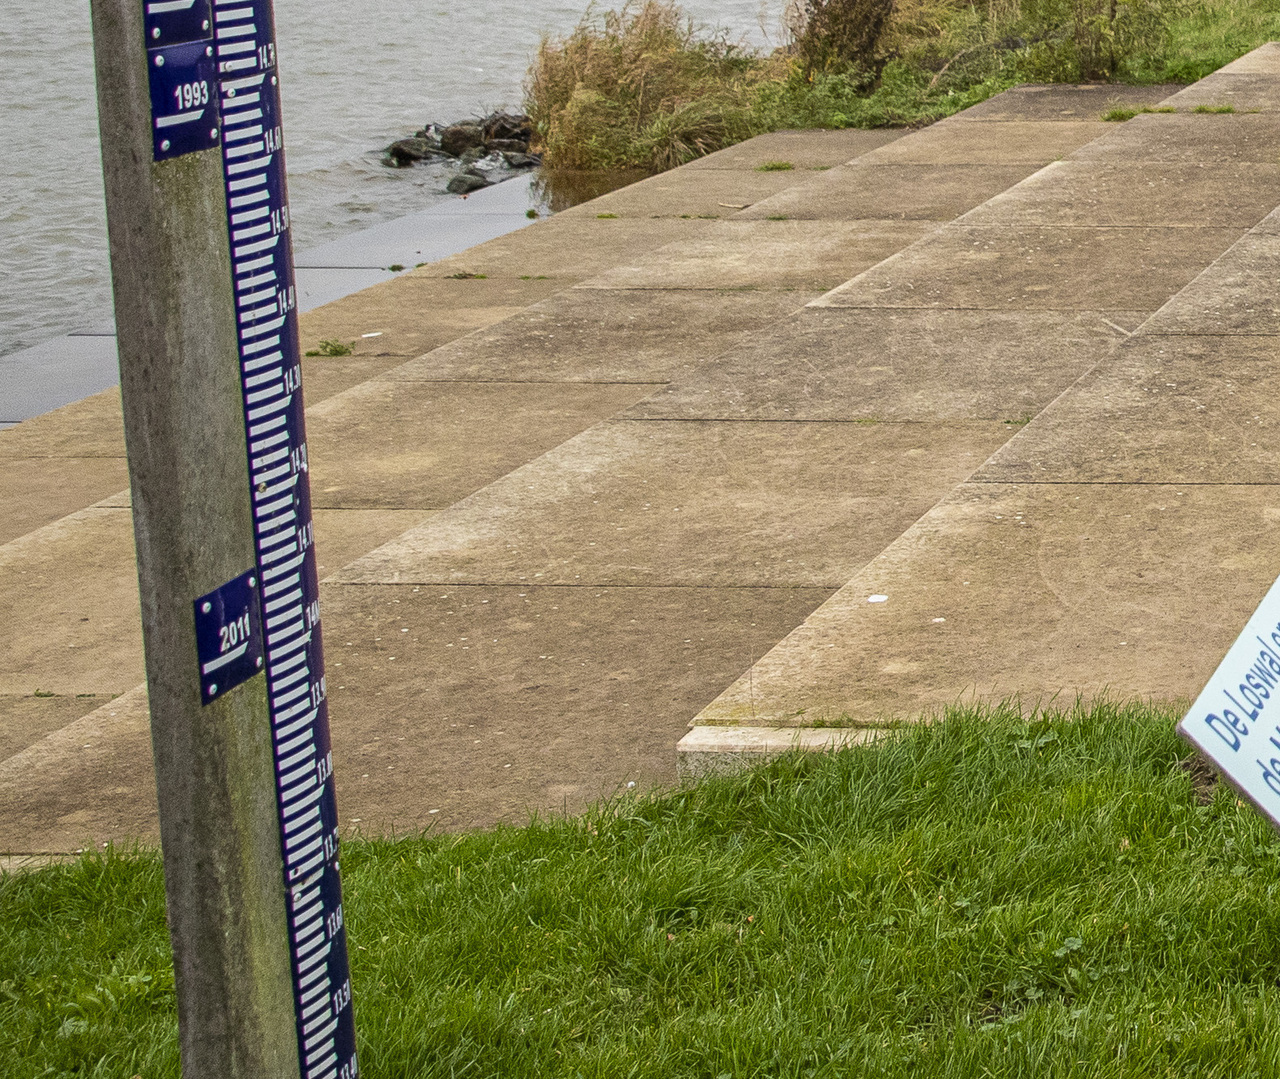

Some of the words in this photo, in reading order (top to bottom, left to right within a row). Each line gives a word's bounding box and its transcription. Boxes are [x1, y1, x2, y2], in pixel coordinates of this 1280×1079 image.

[174, 80, 209, 111] 1993
[220, 612, 250, 652] 2011
[1204, 708, 1249, 753] De
